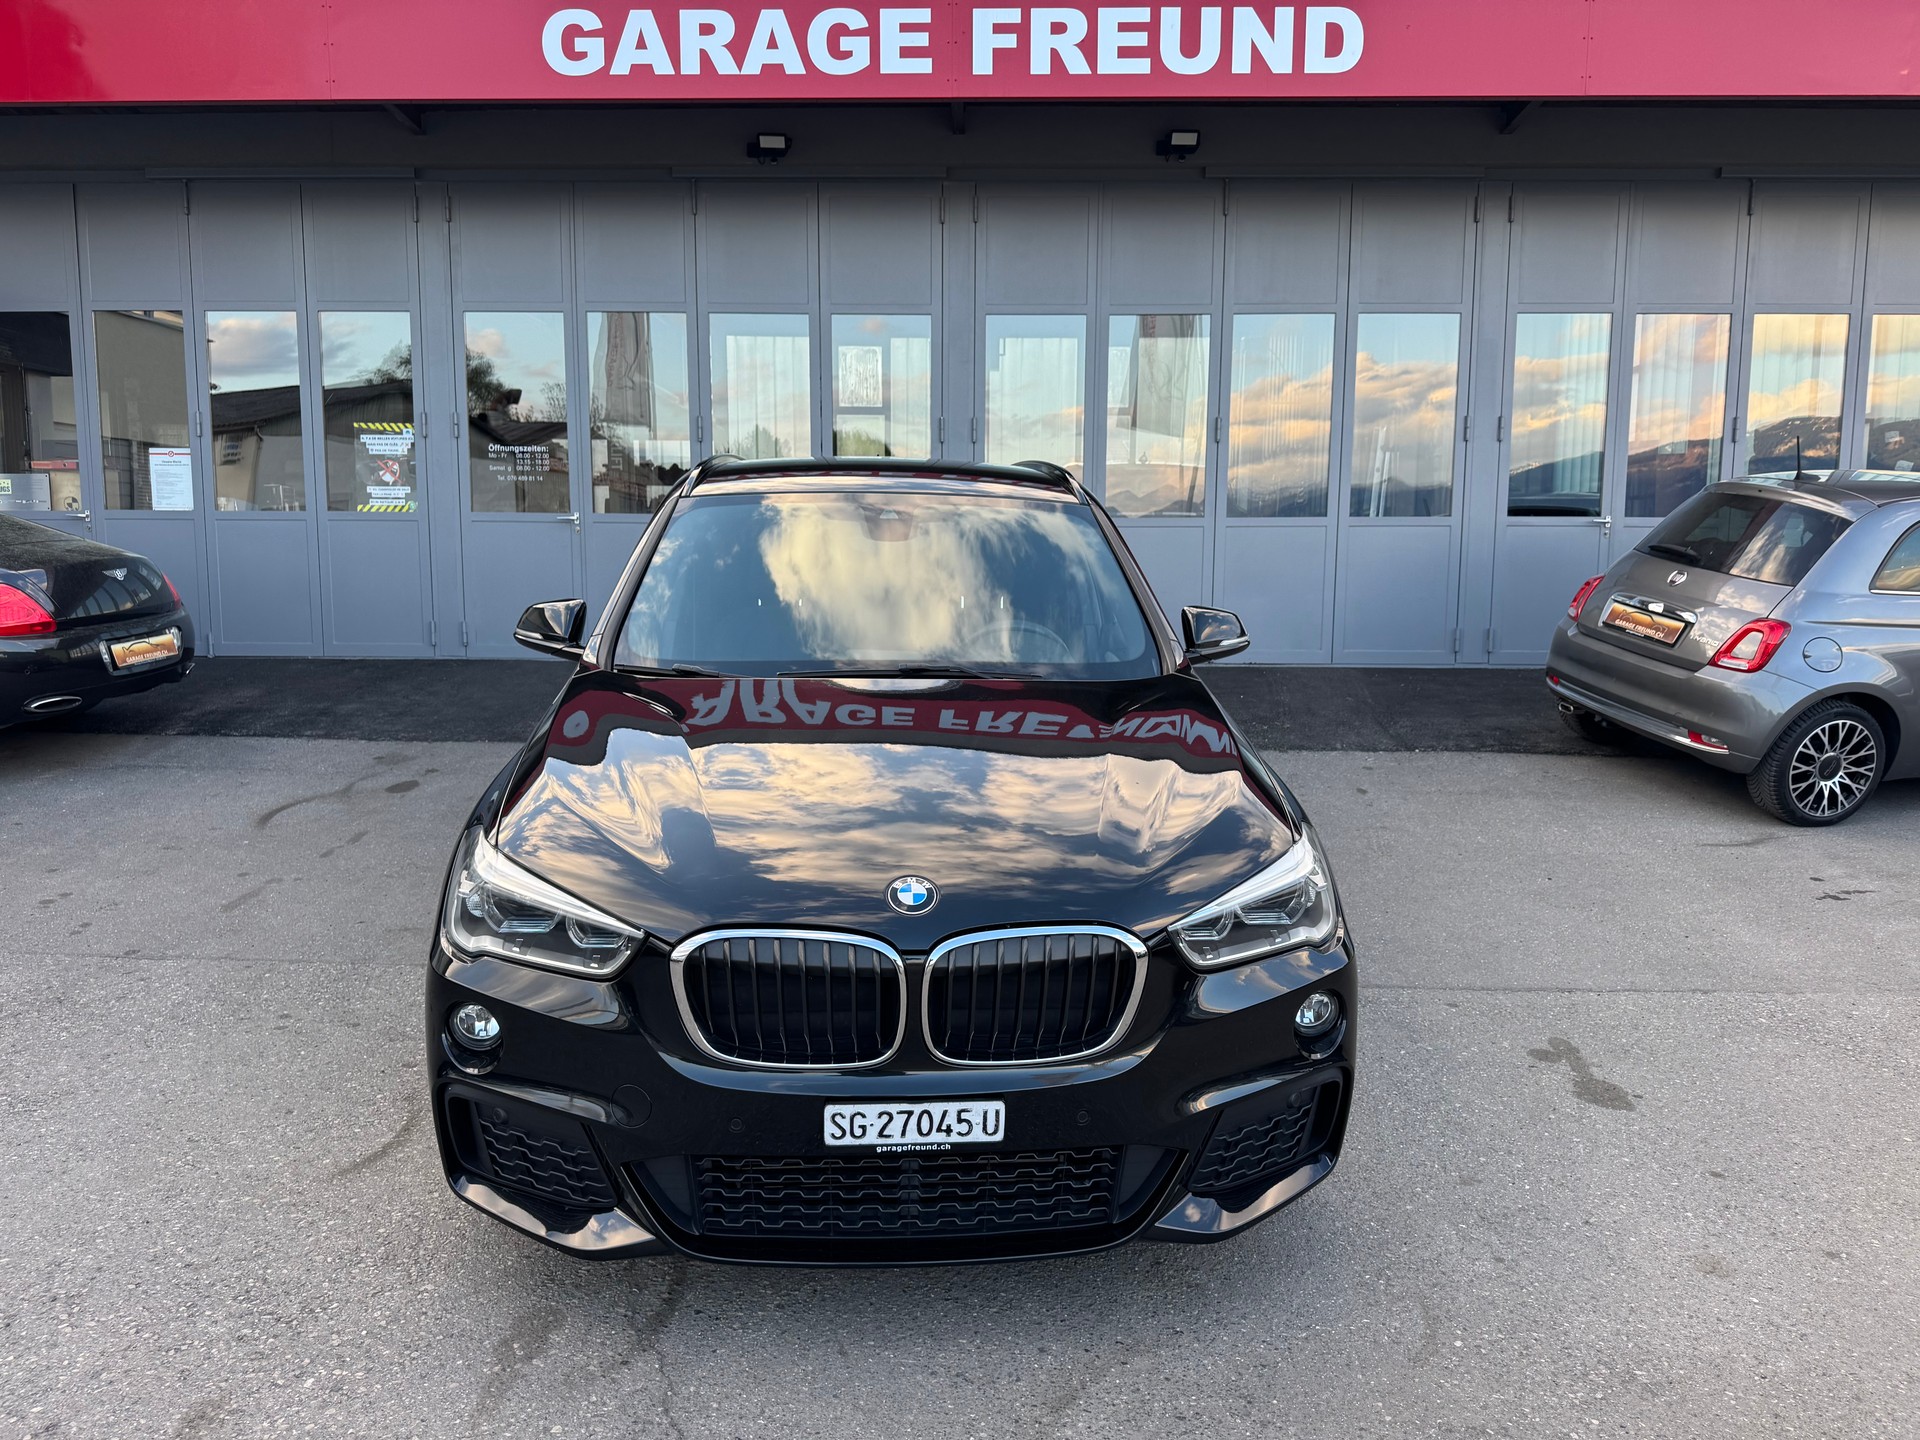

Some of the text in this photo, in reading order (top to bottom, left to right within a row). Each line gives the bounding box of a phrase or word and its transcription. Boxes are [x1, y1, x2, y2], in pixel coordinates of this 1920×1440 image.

[541, 6, 1365, 77] GARAGE FREUND
[488, 443, 549, 453] Öffnungszeiten:
[1615, 618, 1636, 630] GARAGE
[125, 655, 144, 663] GARAGE
[893, 877, 932, 889] BMW
[876, 1144, 951, 1153] garagefreund.ch
